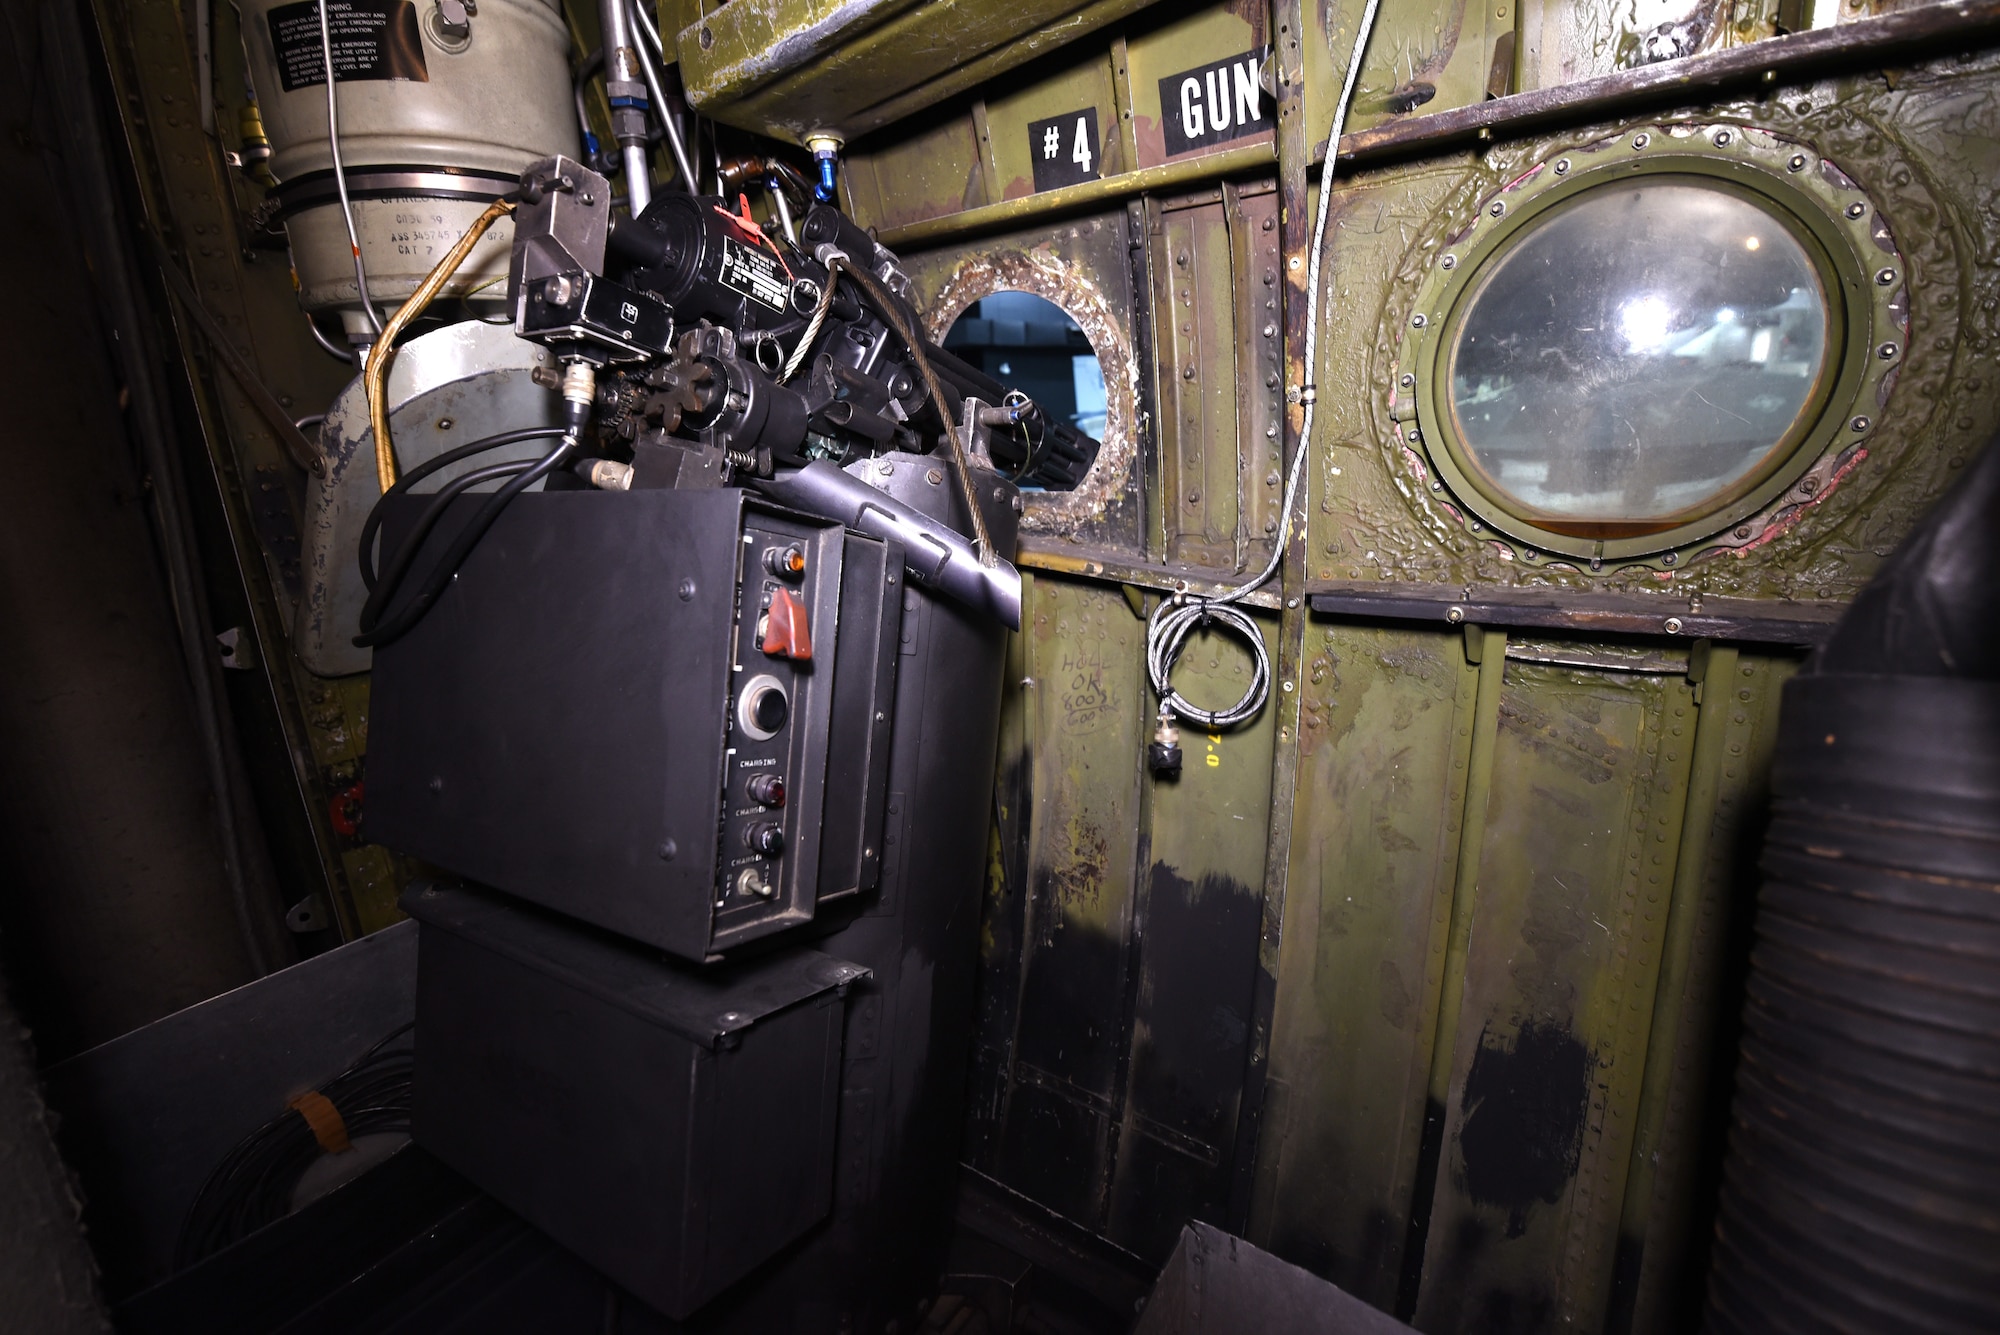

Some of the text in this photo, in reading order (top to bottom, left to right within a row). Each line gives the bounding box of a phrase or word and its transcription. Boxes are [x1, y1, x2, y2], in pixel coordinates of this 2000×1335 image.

[301, 45, 323, 53] REFILLIN
[340, 63, 357, 71] LEVEL
[1179, 57, 1262, 139] GUN
[398, 245, 418, 256] CAT
[740, 758, 776, 768] CHARGING
